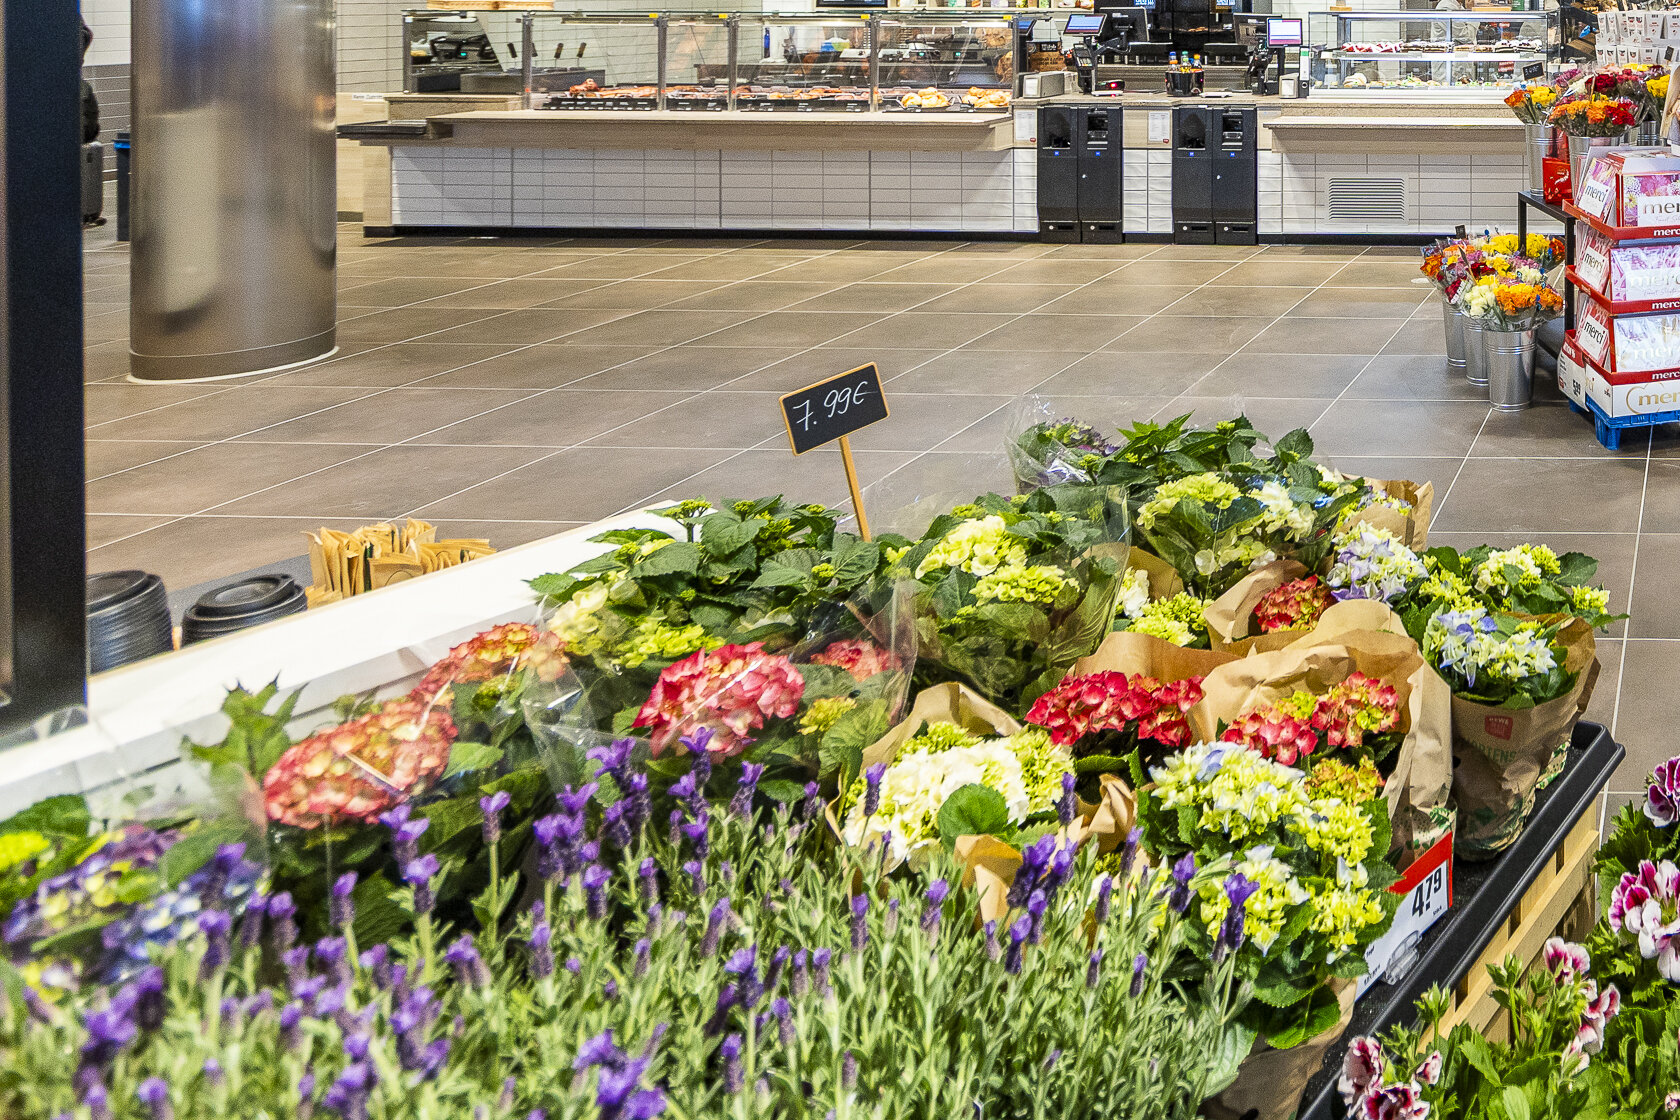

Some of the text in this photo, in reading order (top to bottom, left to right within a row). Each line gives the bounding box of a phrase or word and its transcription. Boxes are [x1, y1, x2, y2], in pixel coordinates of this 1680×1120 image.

[1585, 184, 1609, 203] merci
[1584, 252, 1605, 273] merci
[1584, 321, 1605, 344] merci
